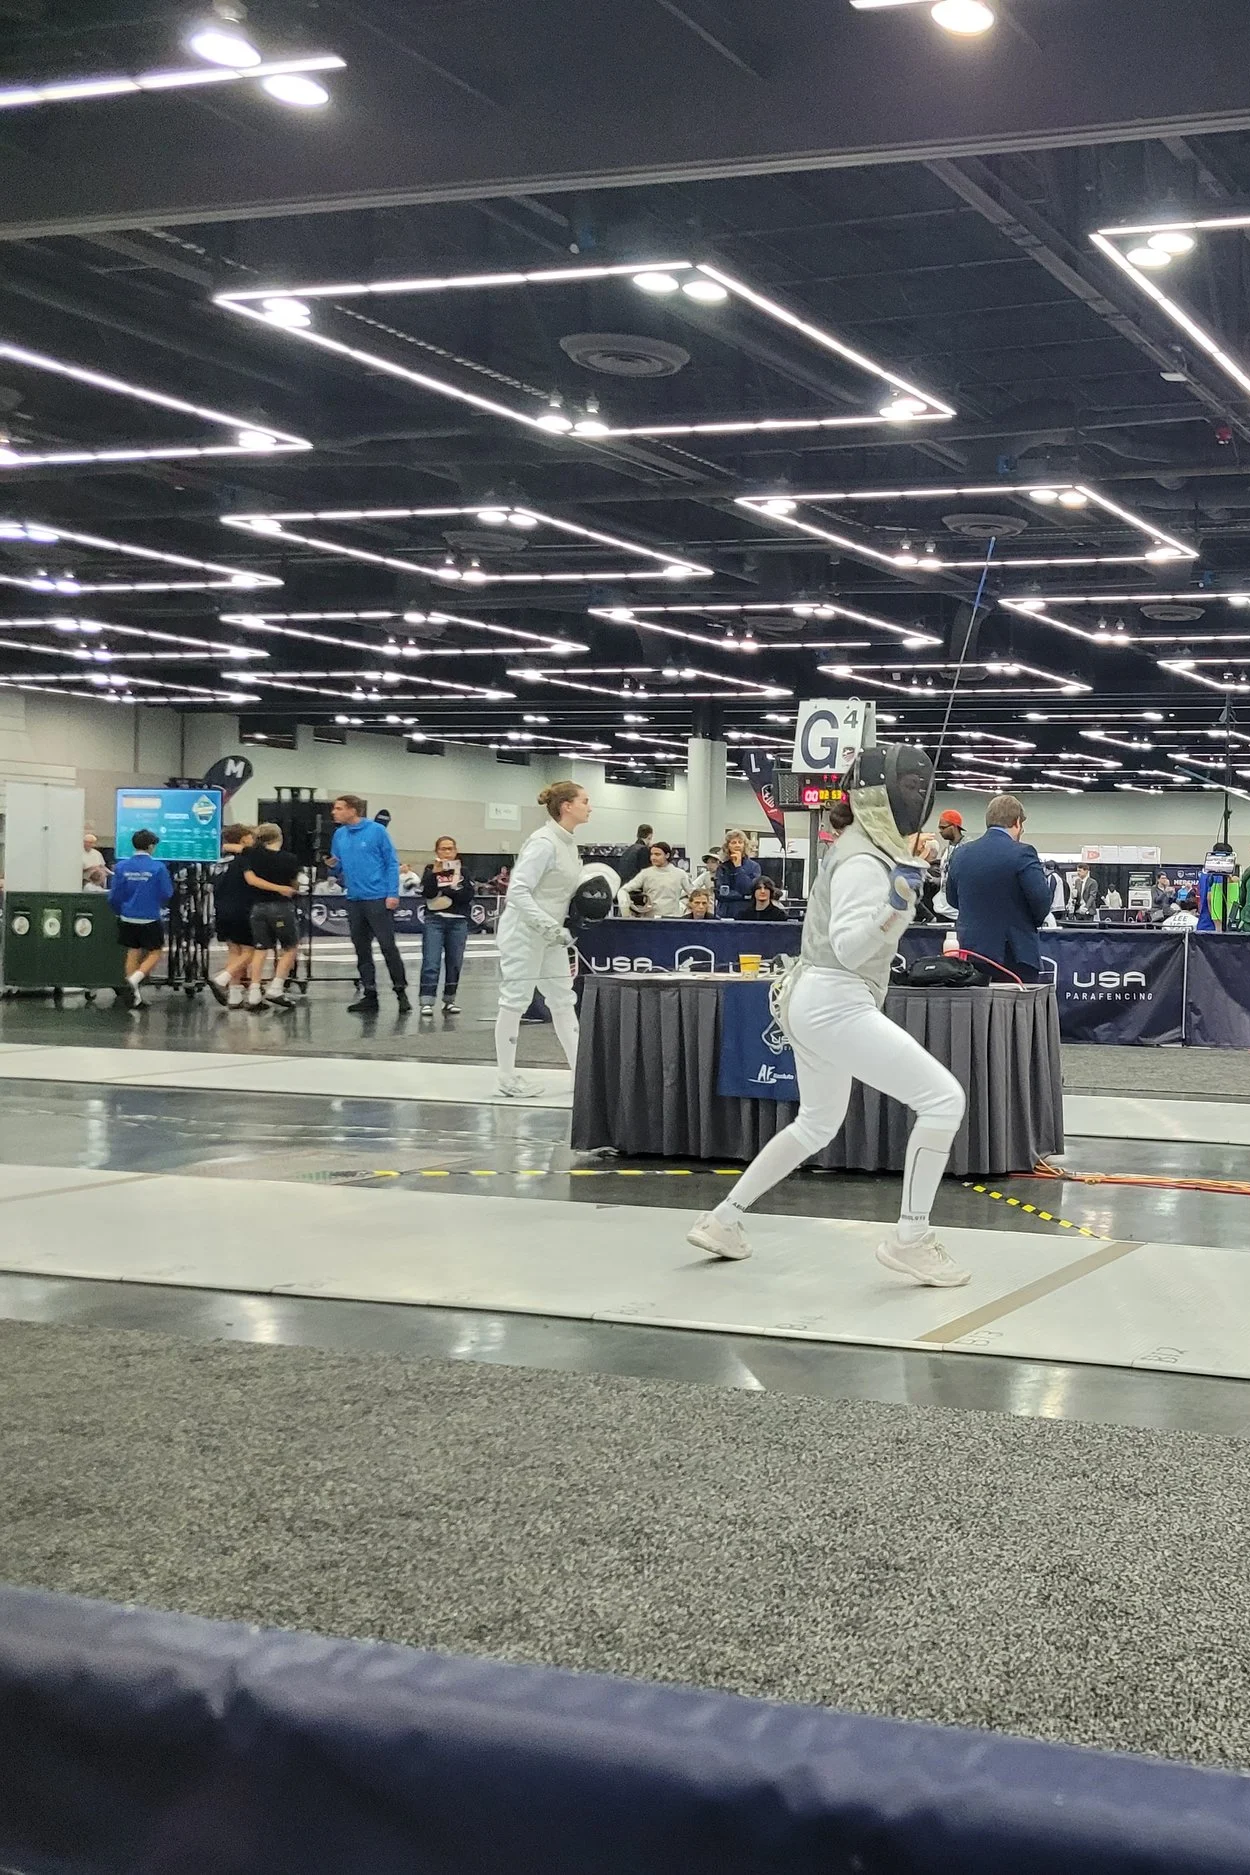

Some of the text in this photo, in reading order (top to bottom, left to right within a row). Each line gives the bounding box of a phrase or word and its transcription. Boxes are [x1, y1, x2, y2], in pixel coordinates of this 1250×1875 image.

[800, 709, 859, 770] G 4
[225, 758, 245, 779] M
[750, 753, 761, 773] L
[591, 955, 653, 973] USA
[1073, 970, 1146, 989] USA
[1065, 991, 1153, 1001] PARAFENCING
